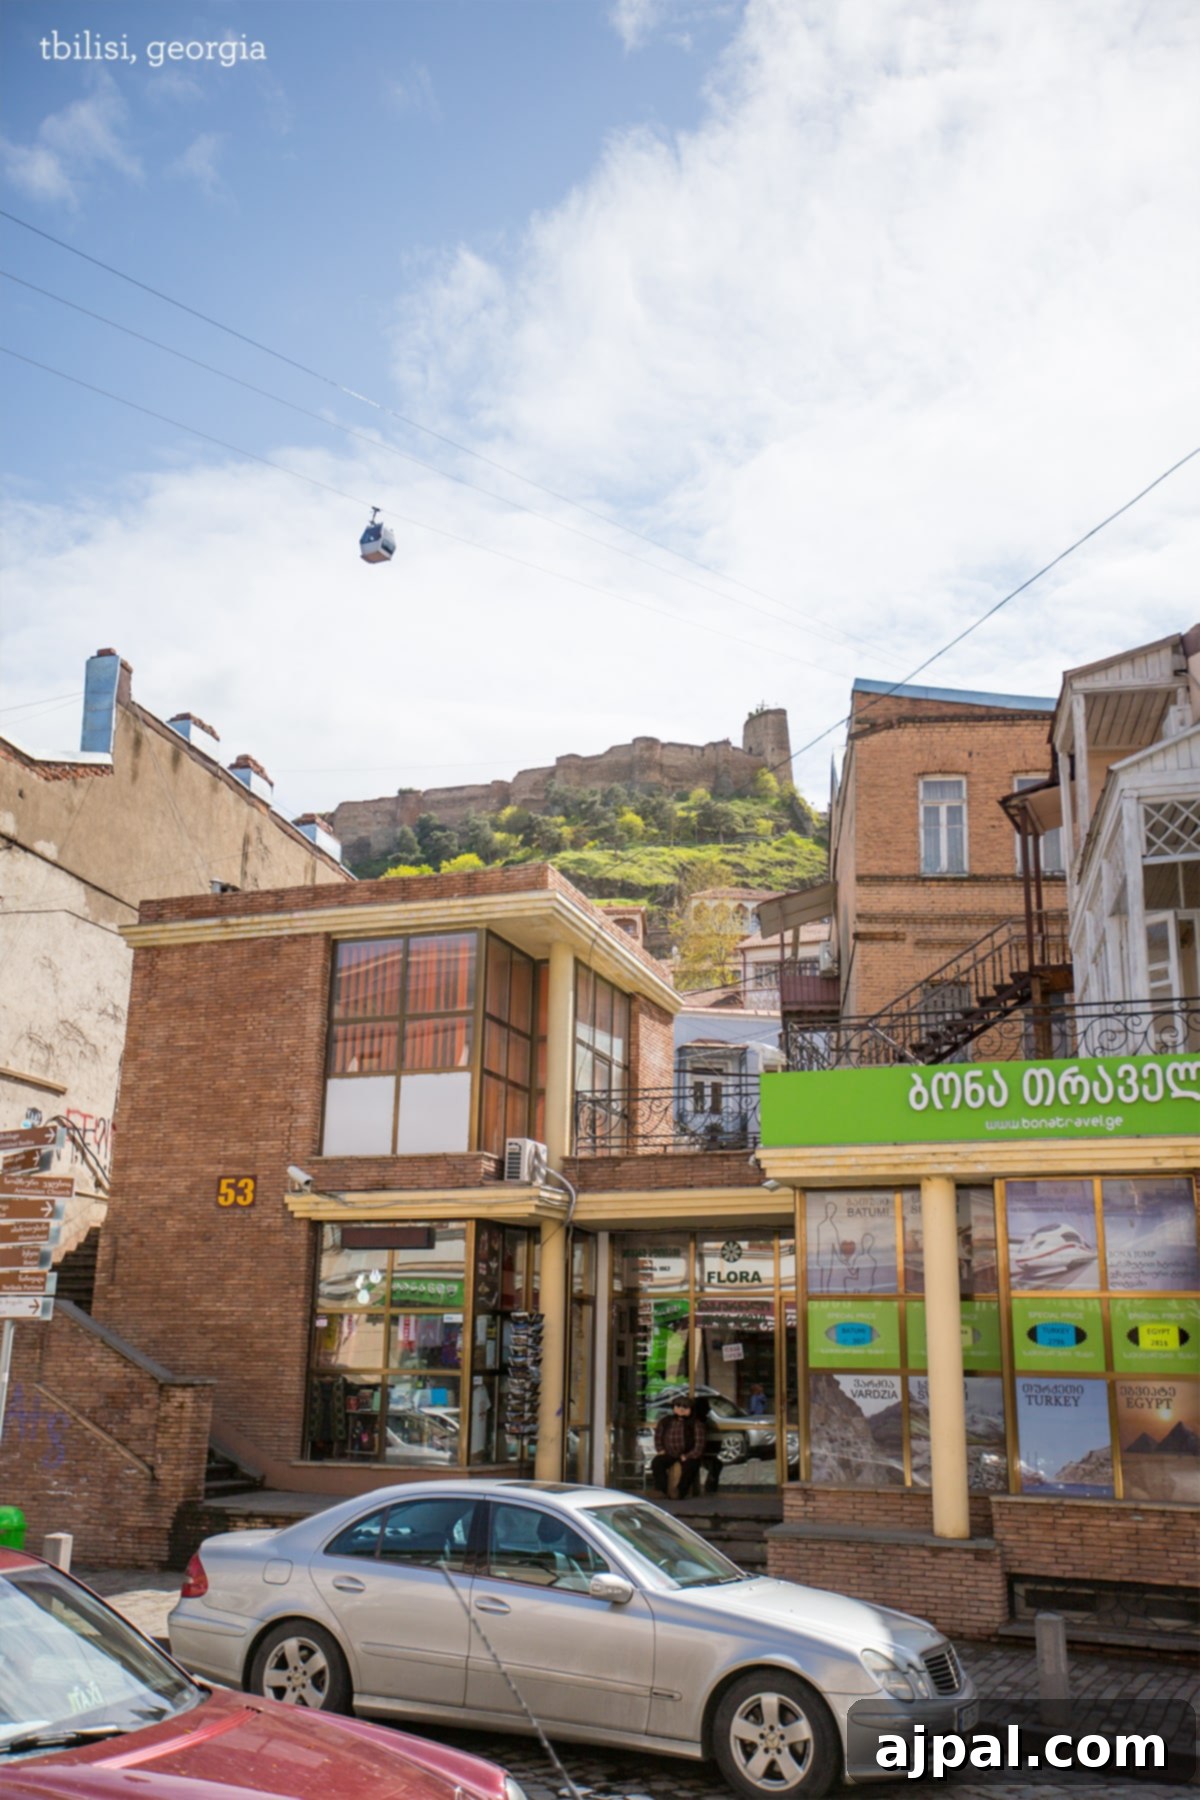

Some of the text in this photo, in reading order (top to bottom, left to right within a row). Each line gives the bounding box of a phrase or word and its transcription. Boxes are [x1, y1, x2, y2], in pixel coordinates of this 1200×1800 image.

[908, 1069, 1009, 1111] ბონა
[985, 1114, 1124, 1131] www.bonatravel.ge
[218, 1177, 255, 1207] 53
[847, 1207, 890, 1218] BATUMI
[706, 1271, 762, 1284] FLORA
[1146, 1327, 1171, 1336] EGYPT
[850, 1389, 898, 1400] VARDZIA
[1025, 1395, 1081, 1408] TURKEY
[1126, 1397, 1173, 1410] EGYPT
